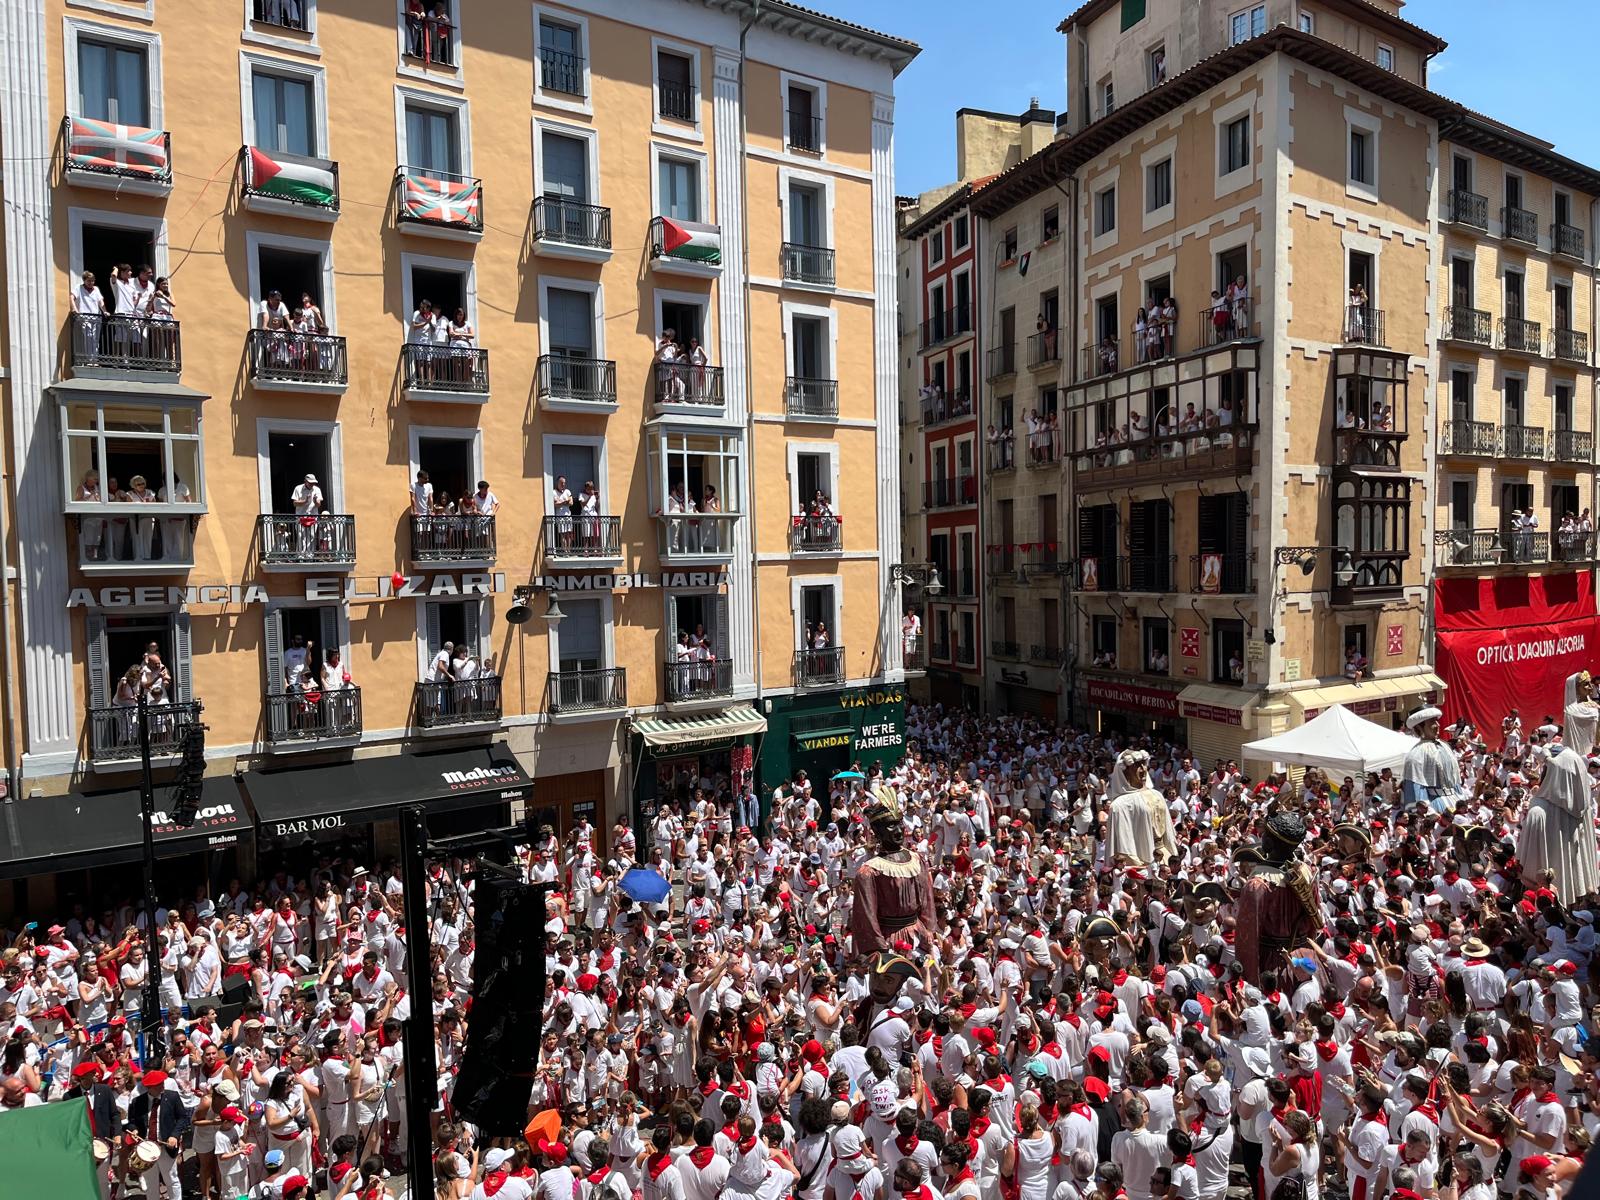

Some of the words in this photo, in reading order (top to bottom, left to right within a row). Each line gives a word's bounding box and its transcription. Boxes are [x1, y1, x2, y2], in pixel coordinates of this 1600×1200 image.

[66, 585, 270, 608] AGENCIA
[305, 573, 505, 600] ELIZARI
[534, 572, 733, 590] INMOBILIARIA
[1476, 644, 1514, 665] OPTICA
[1517, 640, 1555, 661] JOAQUIN
[840, 689, 902, 709] VIANDAS
[1090, 687, 1133, 702] BOCADILLOS
[1135, 694, 1140, 704] Y
[1141, 695, 1176, 710] BEBIDAS
[862, 722, 895, 736] WE'RE
[804, 735, 850, 750] VIANDAS
[854, 734, 902, 751] FARMERS
[441, 766, 516, 784] Mahou
[450, 779, 489, 790] DESDE
[494, 775, 520, 784] 1890
[500, 790, 523, 799] Mahou
[202, 816, 237, 827] 1890
[275, 820, 309, 836] BAR
[311, 815, 346, 831] MOL
[208, 835, 237, 845] Mahou
[874, 1094, 888, 1102] my
